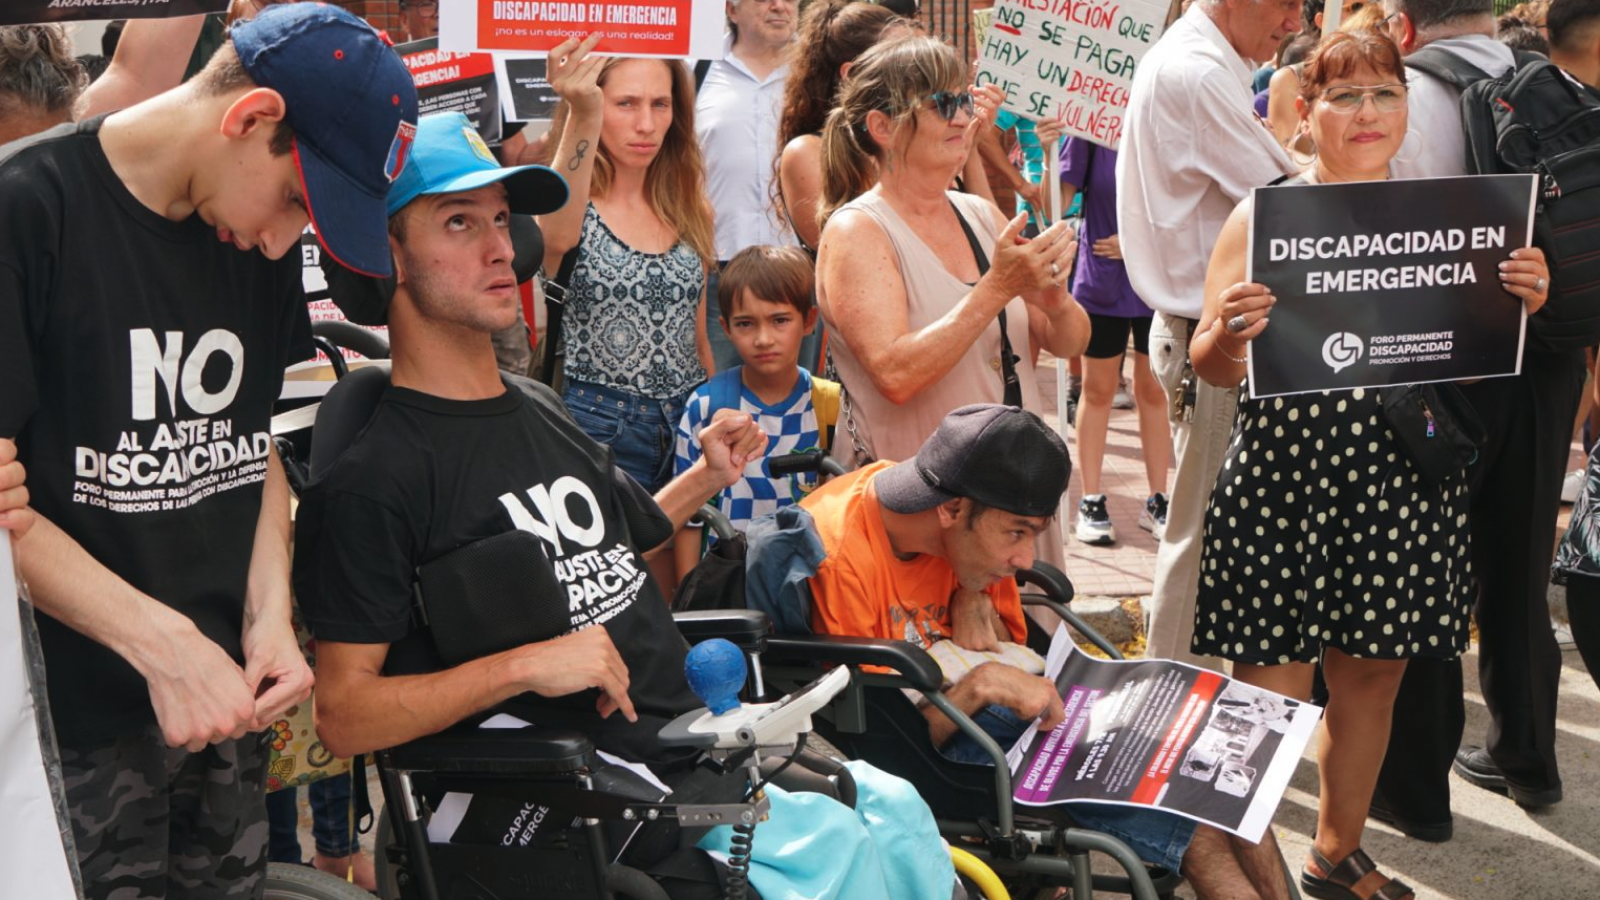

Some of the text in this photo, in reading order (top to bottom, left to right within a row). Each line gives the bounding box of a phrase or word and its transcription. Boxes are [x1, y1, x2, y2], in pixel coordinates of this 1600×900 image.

[493, 0, 677, 26] DISCAPACIDAD EN EMERGENCIA
[629, 31, 674, 41] realidad!
[997, 6, 1135, 81] NO SE PAGA
[1118, 16, 1154, 43] QUE
[984, 35, 1131, 108] HAY UN DERECH
[1026, 91, 1051, 116] SE
[1269, 226, 1505, 262] DISCAPACIDAD EN
[1306, 262, 1477, 294] EMERGENCIA
[1369, 341, 1453, 356] DISCAPACIDAD
[1370, 331, 1453, 344] FORO PERMANENTE
[1369, 356, 1410, 365] PROMOCIÓN
[1417, 353, 1451, 362] DERECHOS
[130, 328, 244, 421] NO
[116, 431, 143, 451] AL
[212, 419, 232, 441] EN
[74, 481, 102, 495] FORO
[103, 489, 165, 501] PERMANENTE
[228, 469, 238, 479] LA
[73, 493, 88, 504] DE
[90, 496, 107, 508] LOS
[108, 502, 160, 514] DERECHOS
[162, 501, 174, 510] DE
[202, 486, 216, 497] CON
[498, 476, 605, 557] NO
[603, 543, 628, 565] EN
